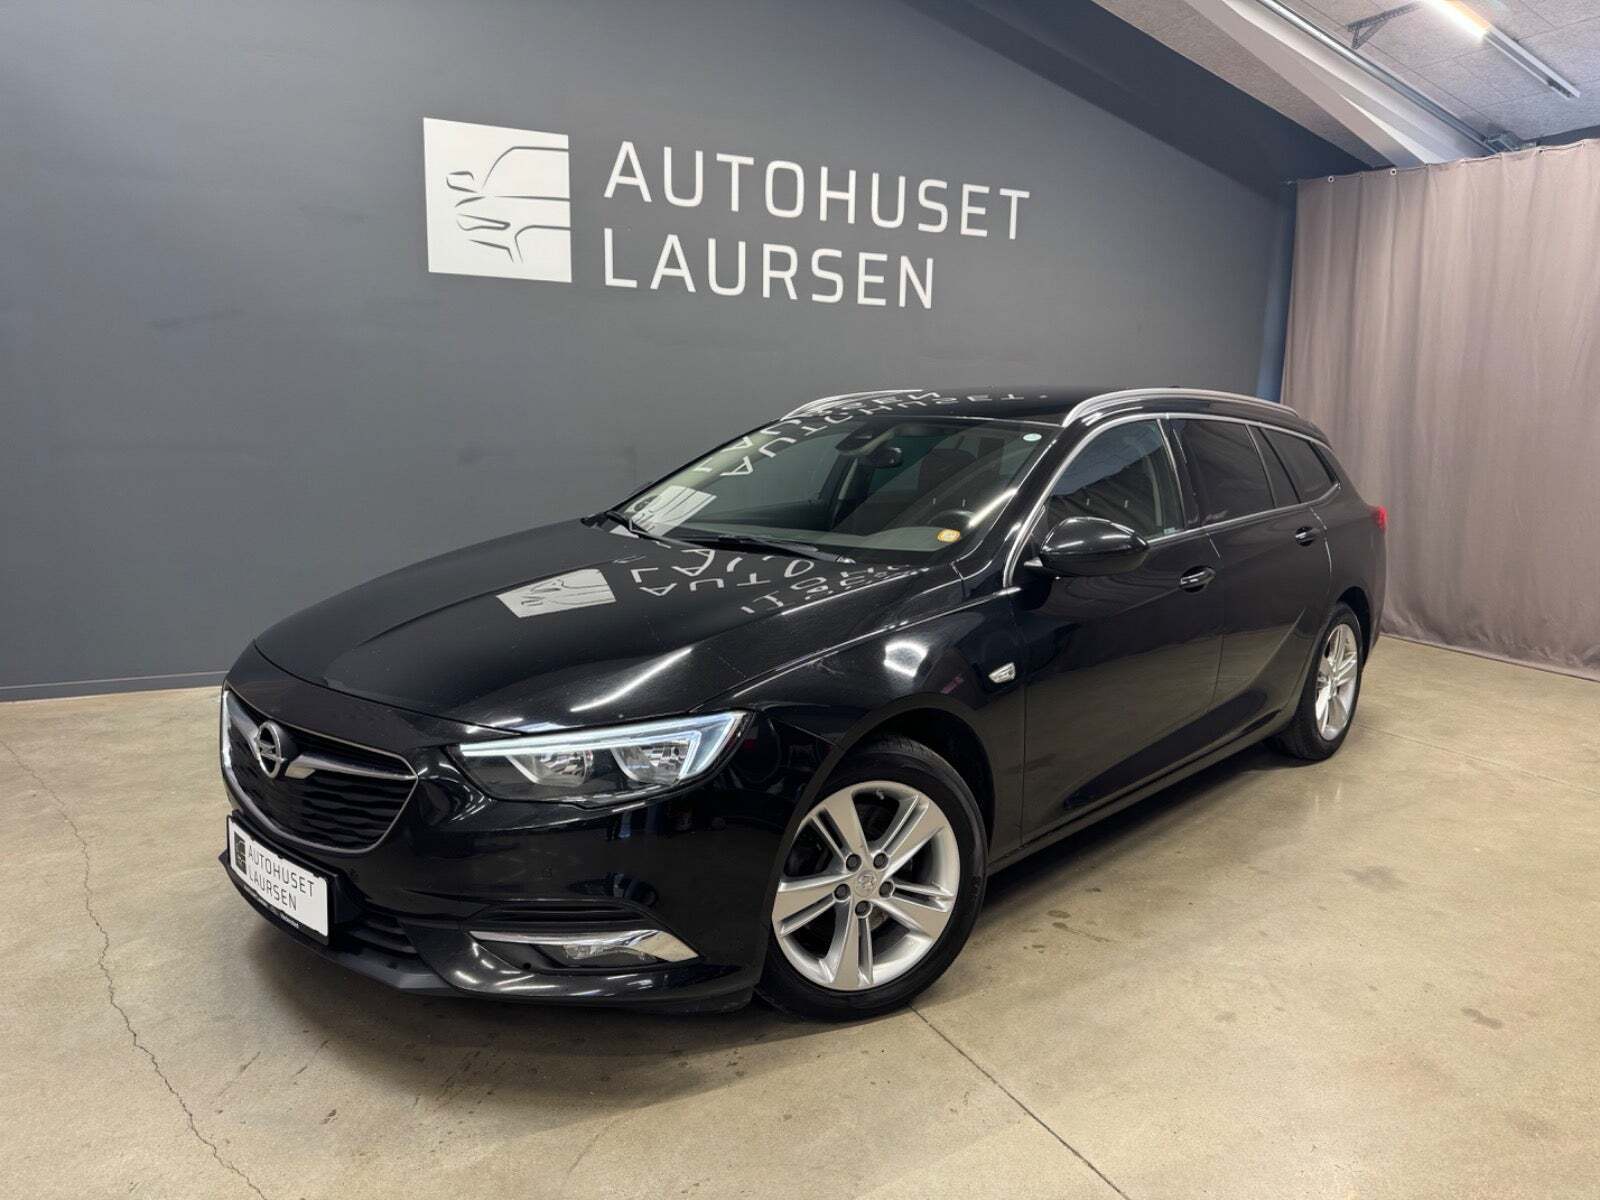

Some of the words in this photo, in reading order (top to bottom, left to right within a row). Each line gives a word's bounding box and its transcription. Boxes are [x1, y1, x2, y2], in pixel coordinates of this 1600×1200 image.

[603, 140, 1030, 241] AUTOHUSET
[603, 228, 935, 310] LAURSEN
[248, 844, 315, 898] AUTOHUSET
[249, 865, 297, 912] LAURSEN
